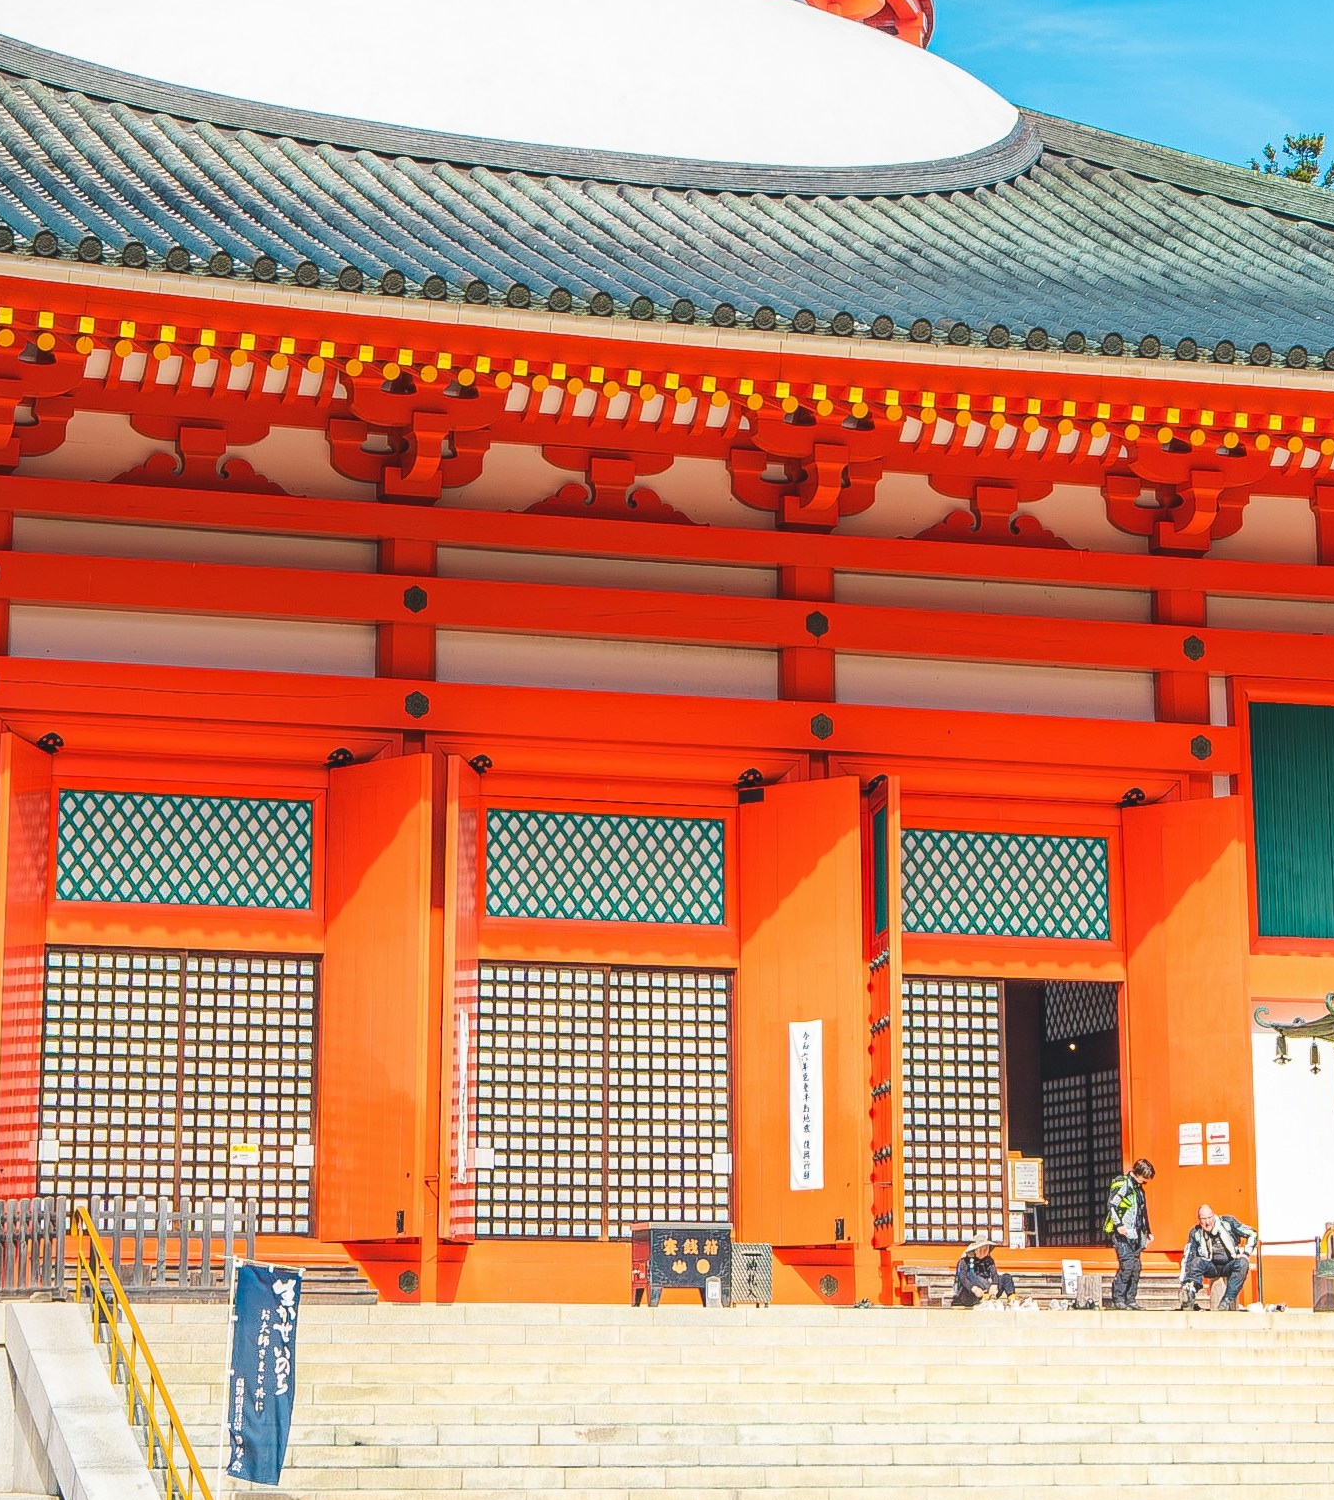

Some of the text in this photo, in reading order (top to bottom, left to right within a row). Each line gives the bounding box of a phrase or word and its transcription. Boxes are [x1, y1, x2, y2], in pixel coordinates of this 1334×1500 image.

[255, 1308, 271, 1412] お大師さまと共に
[272, 1279, 297, 1395] 生かせいのち
